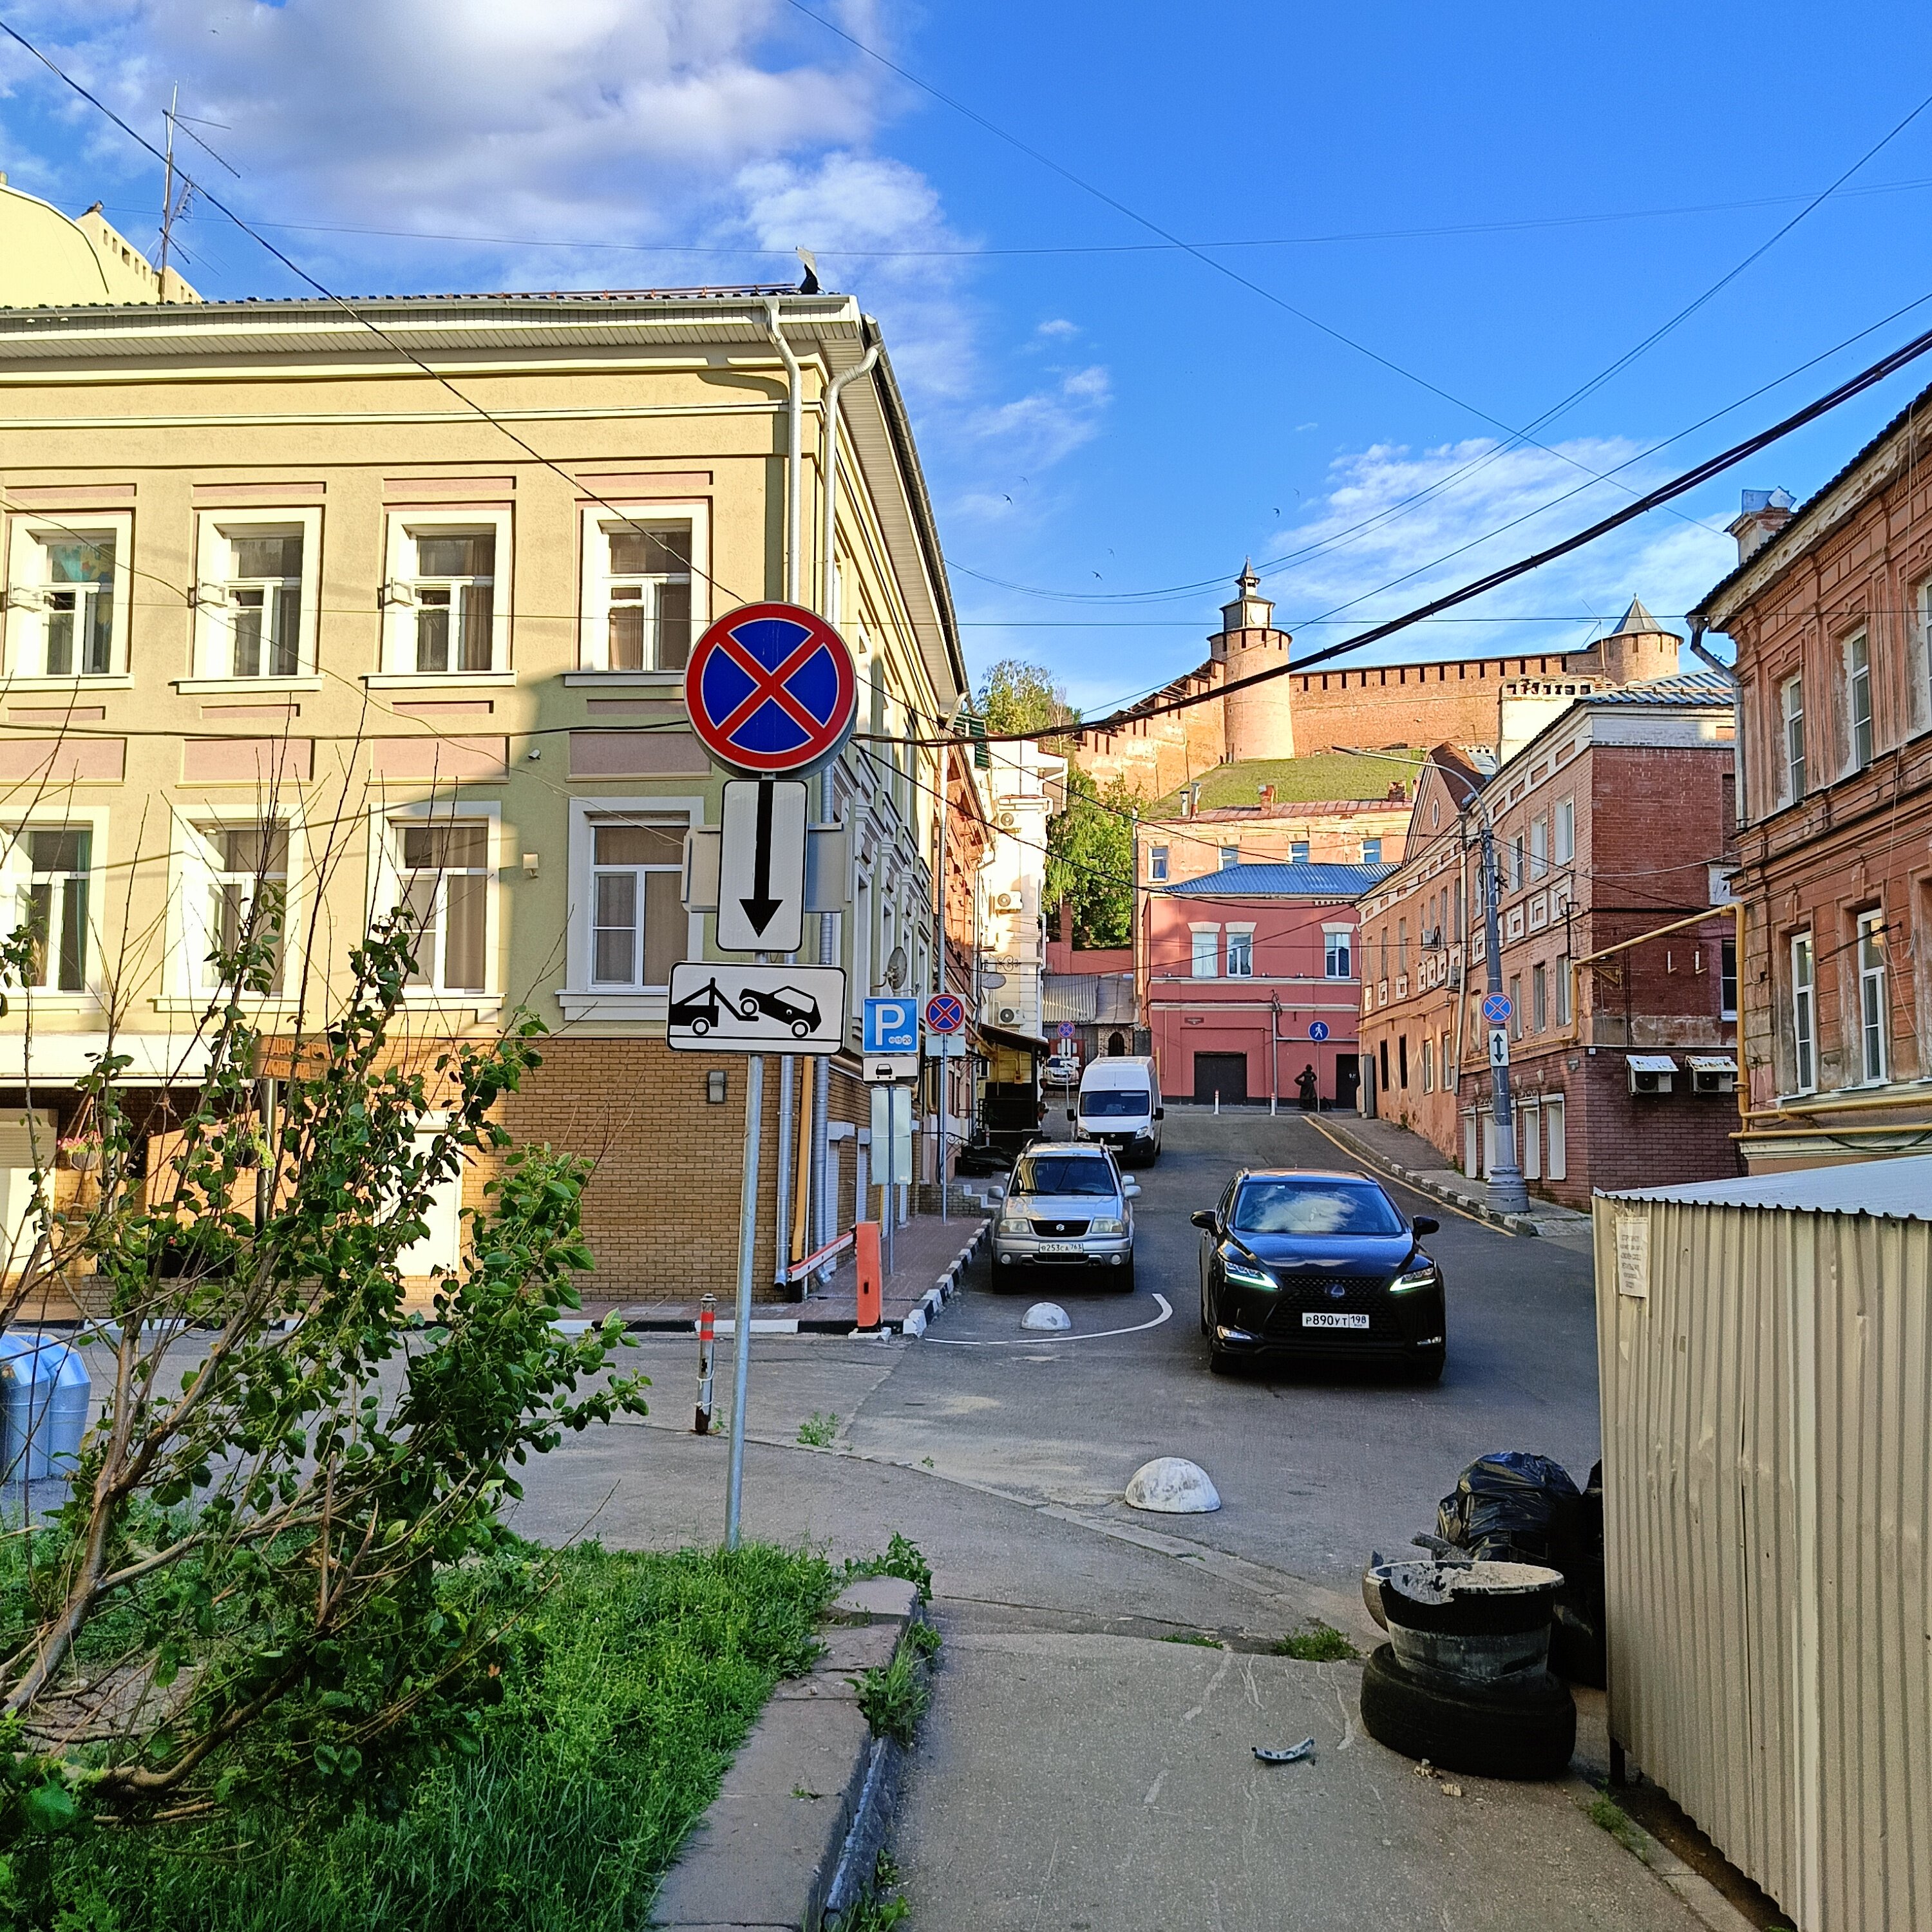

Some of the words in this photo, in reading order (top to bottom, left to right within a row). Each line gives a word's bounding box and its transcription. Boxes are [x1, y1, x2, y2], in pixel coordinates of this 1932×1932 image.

[876, 1004, 905, 1045] P
[1305, 1314, 1347, 1326] Р890УТ
[1350, 1315, 1367, 1324] 198
